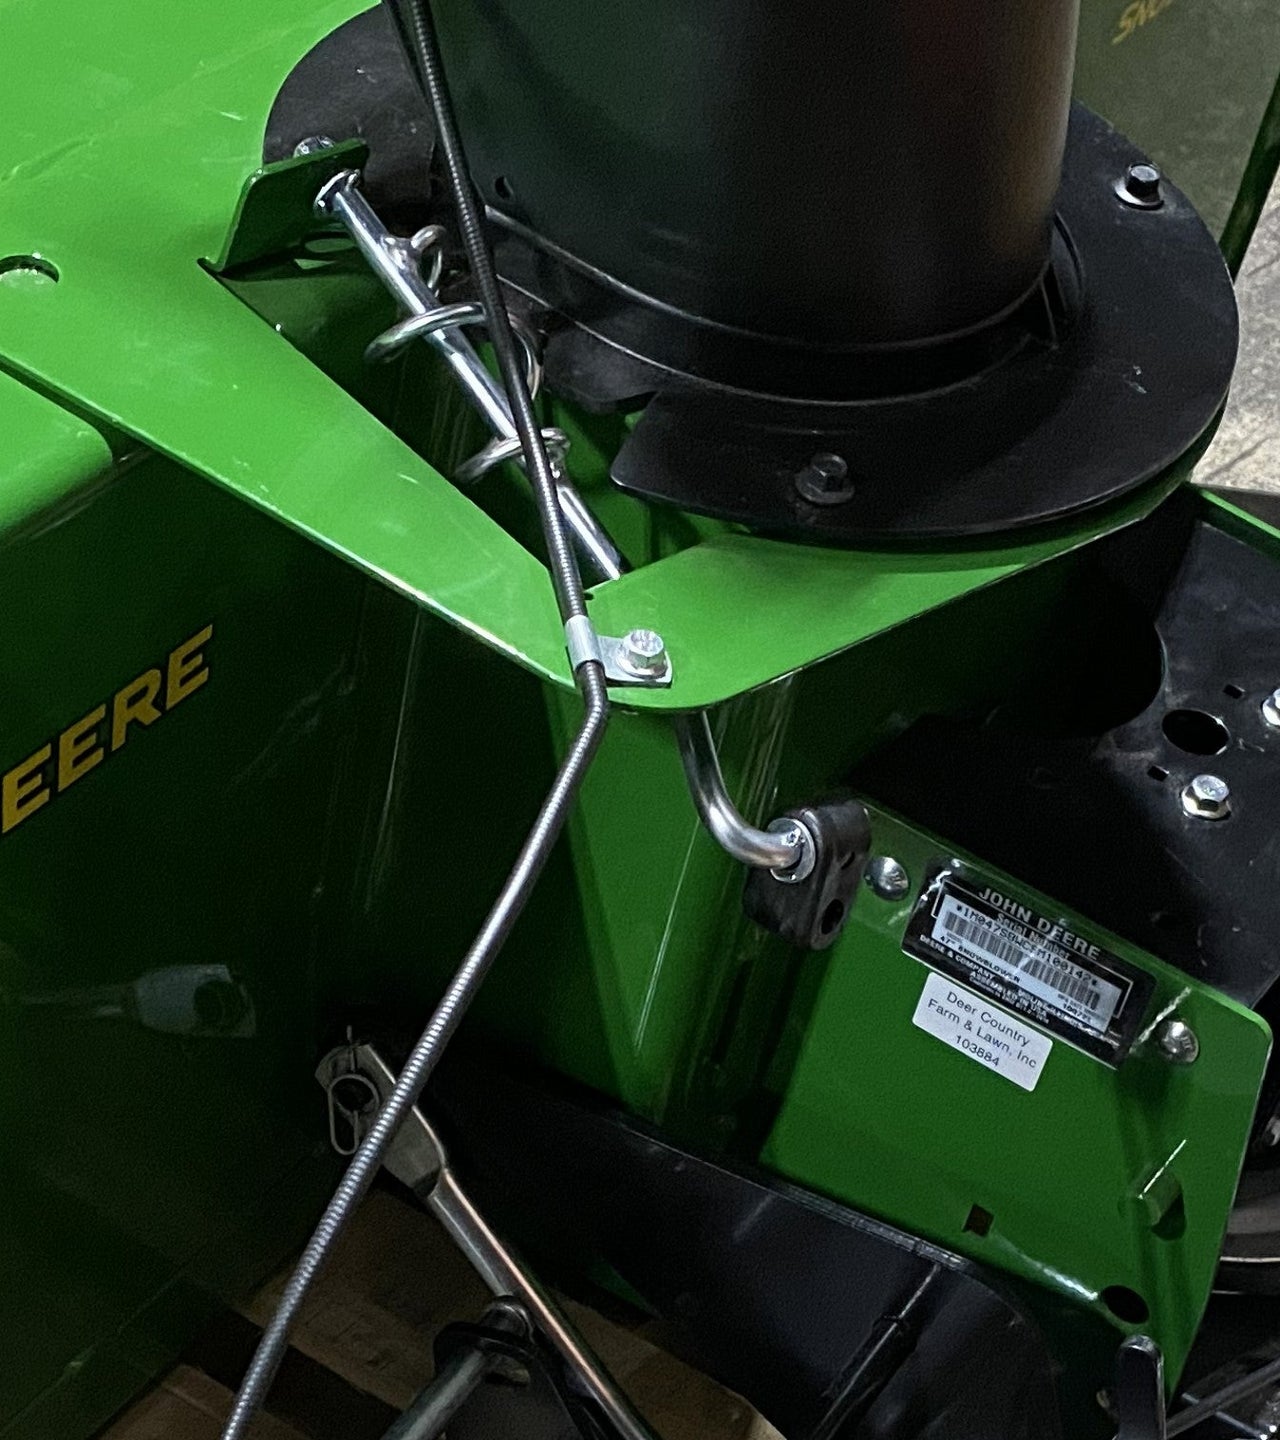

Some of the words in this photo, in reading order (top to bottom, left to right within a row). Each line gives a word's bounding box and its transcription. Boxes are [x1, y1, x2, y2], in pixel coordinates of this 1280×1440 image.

[978, 887, 1030, 920] JOHN
[1037, 919, 1099, 959] DEERE
[995, 913, 1028, 935] Serial
[927, 997, 961, 1024] Farm
[963, 1018, 974, 1031] &
[976, 1026, 1015, 1055] Lawn,
[1016, 1049, 1037, 1068] Inc
[945, 990, 978, 1016] Deer
[979, 1011, 1030, 1046] Country
